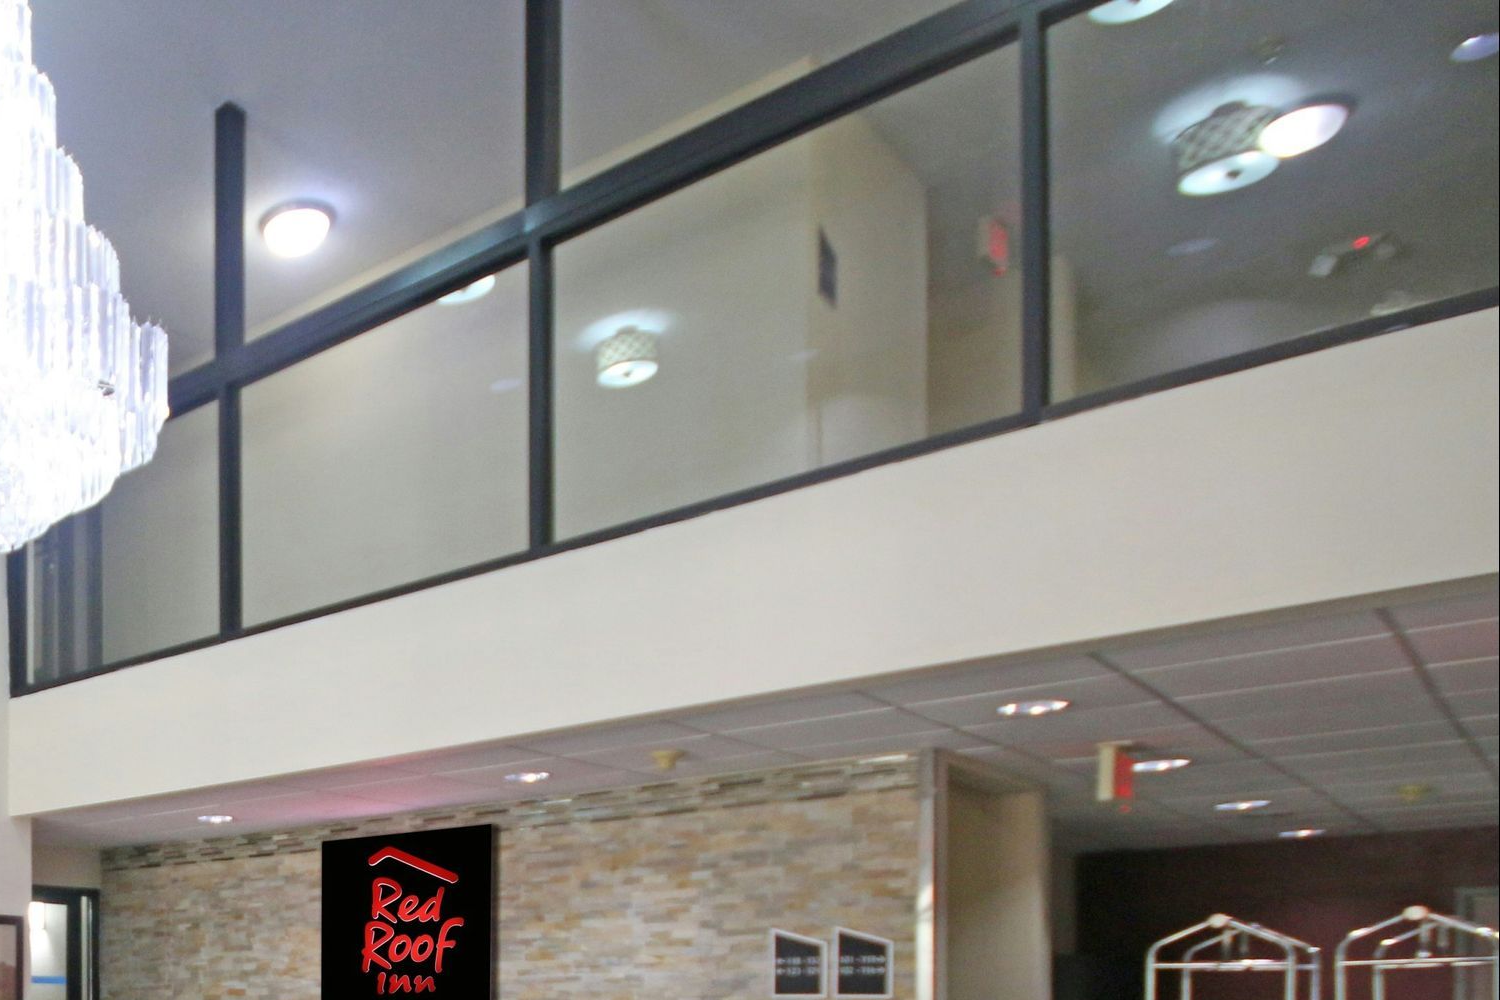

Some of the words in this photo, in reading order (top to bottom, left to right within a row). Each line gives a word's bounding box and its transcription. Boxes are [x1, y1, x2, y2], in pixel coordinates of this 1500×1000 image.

[372, 877, 445, 923] Red
[362, 917, 464, 972] Roof
[377, 972, 436, 994] Inn
